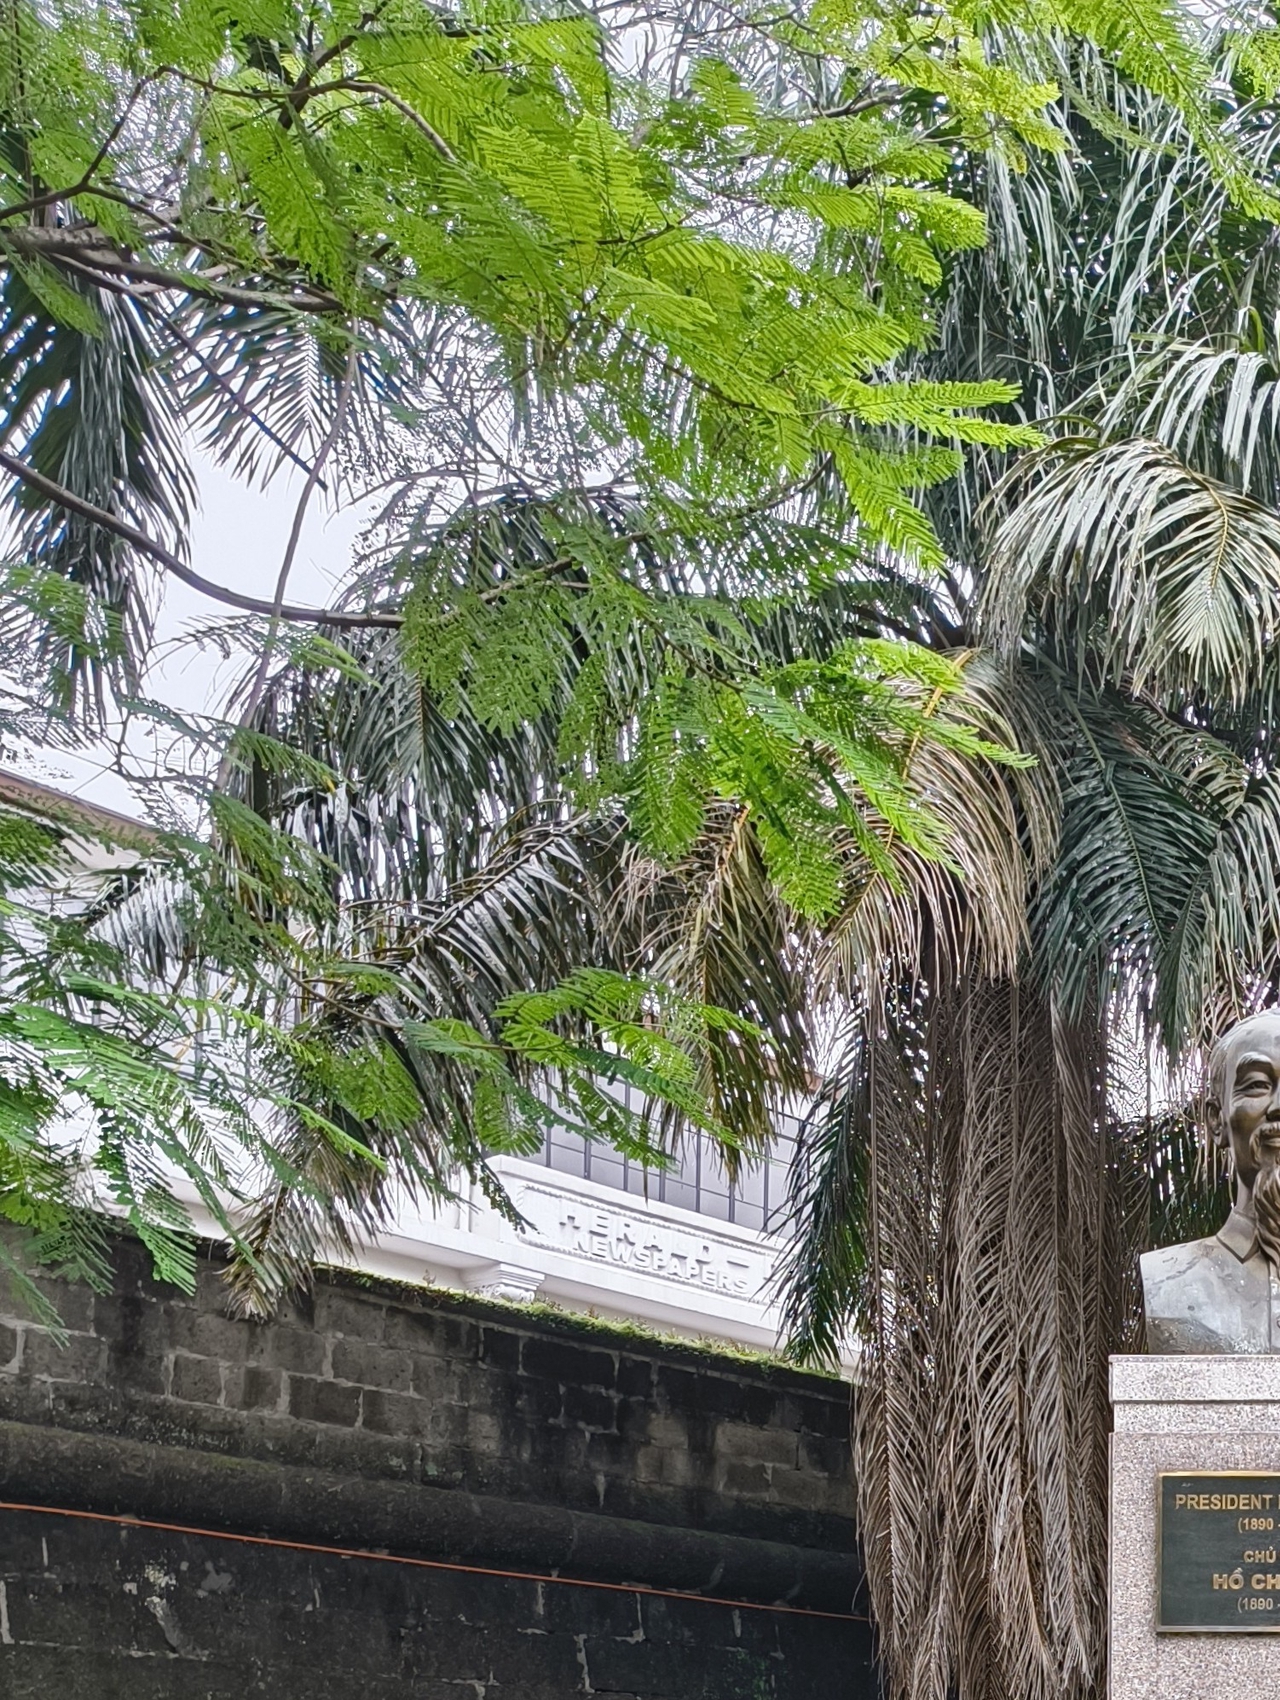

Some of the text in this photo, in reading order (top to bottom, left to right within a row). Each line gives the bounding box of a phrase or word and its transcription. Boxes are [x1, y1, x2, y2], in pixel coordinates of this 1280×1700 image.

[559, 1207, 714, 1263] HERALD
[572, 1233, 748, 1293] NEWSPAPERS
[1175, 1494, 1273, 1510] PRESIDENT
[1237, 1518, 1274, 1533] (1890
[1243, 1546, 1276, 1563] CHỦ
[1212, 1567, 1244, 1590] HỒ
